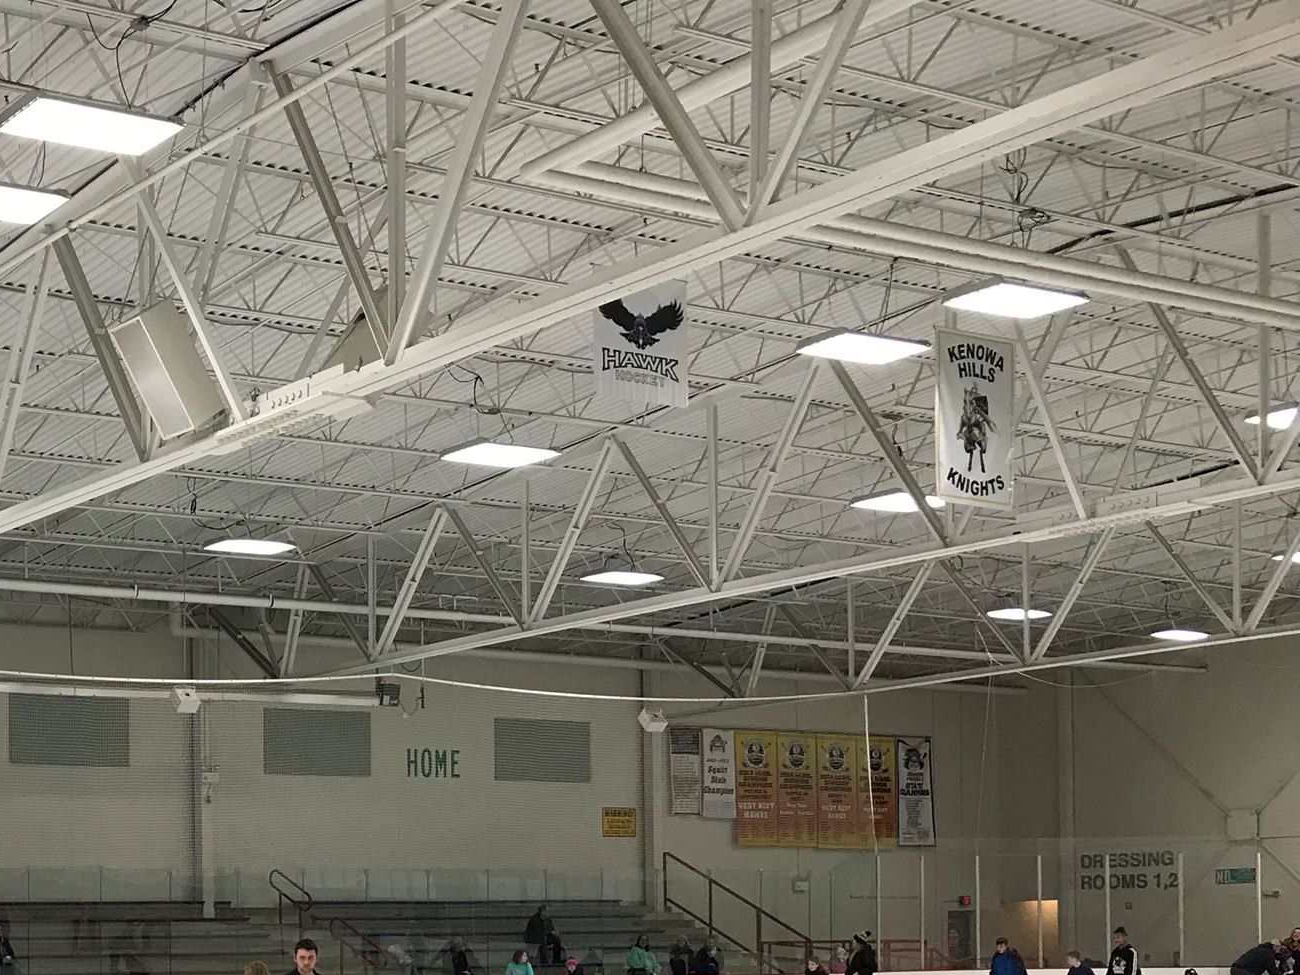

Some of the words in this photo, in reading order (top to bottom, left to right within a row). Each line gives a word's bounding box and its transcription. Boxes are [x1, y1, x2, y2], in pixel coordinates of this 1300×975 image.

[602, 347, 679, 383] HAWK
[947, 343, 1005, 372] KENOWA
[615, 369, 667, 388] HOCKEY
[958, 361, 996, 383] HILLS
[946, 467, 1005, 497] KNIGHTS
[406, 747, 460, 778] HOME
[1080, 850, 1174, 869] DRESSING
[1080, 873, 1148, 890] ROOMS
[1153, 872, 1179, 890] 1,2
[1216, 870, 1231, 884] NO
